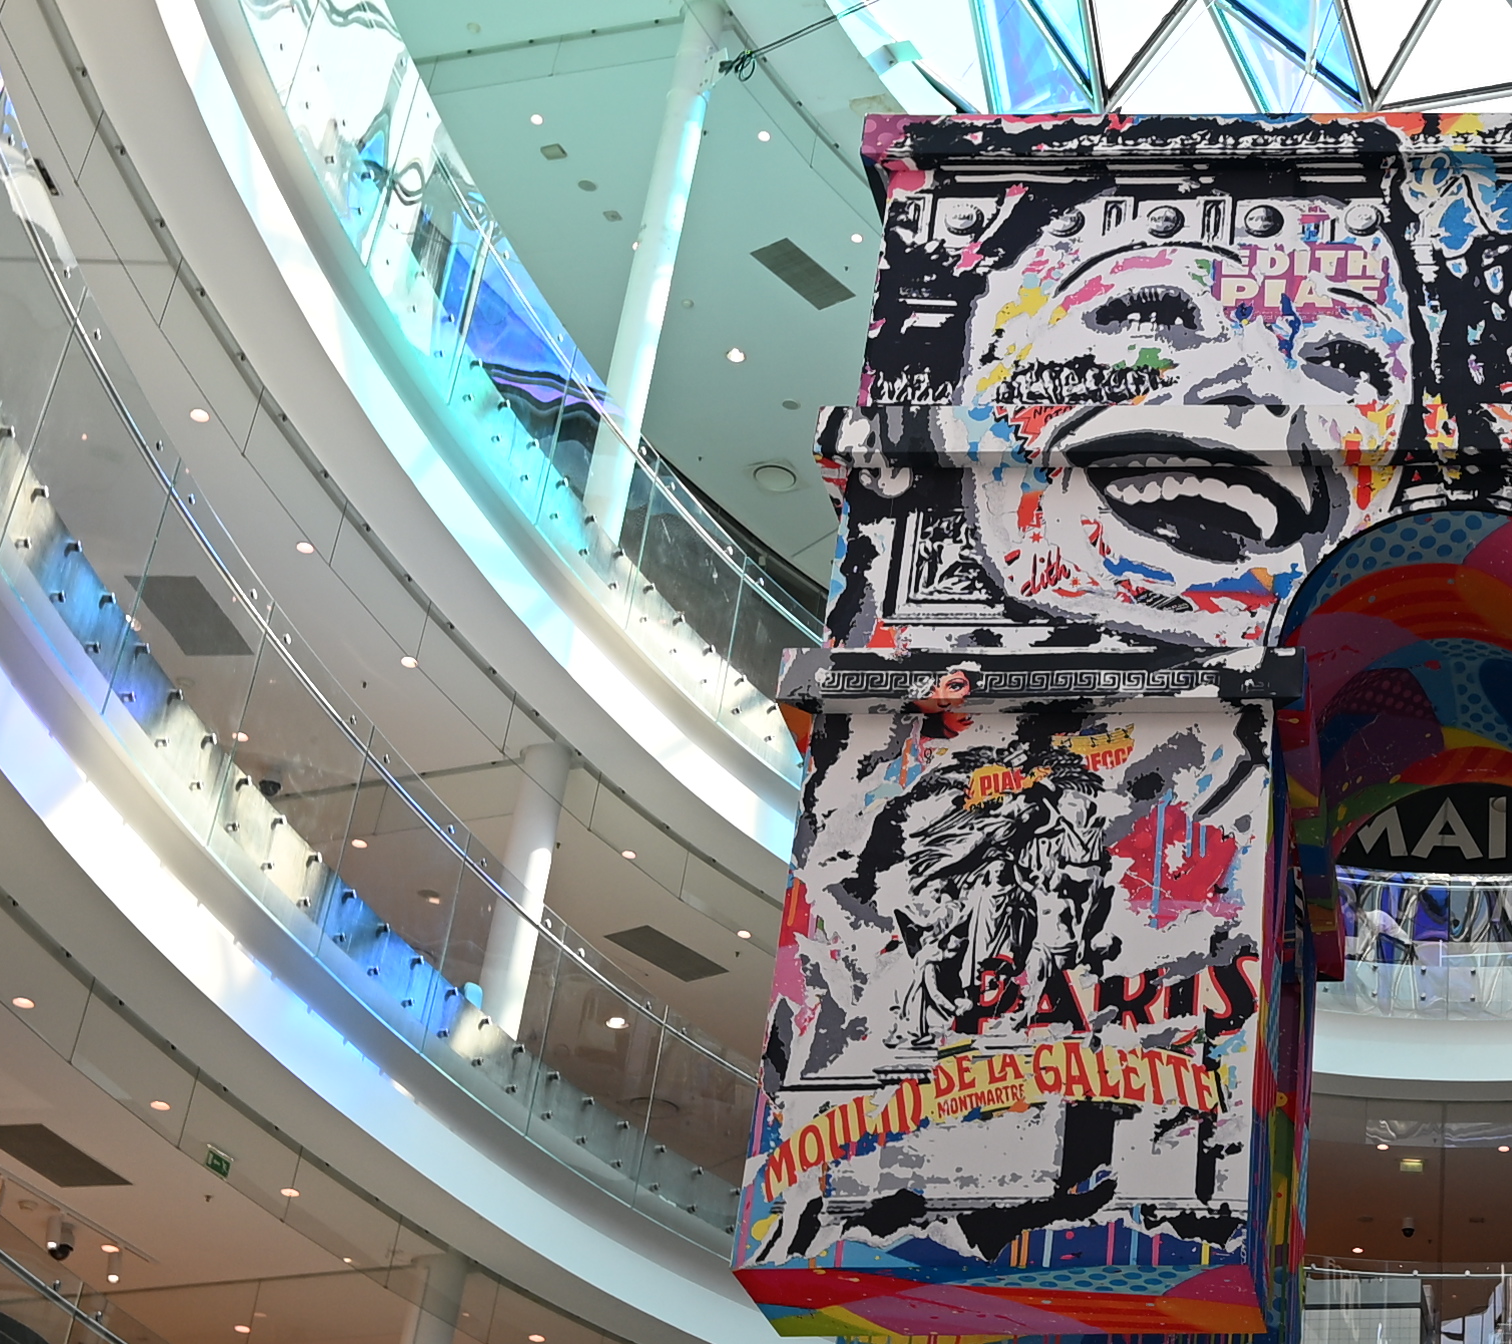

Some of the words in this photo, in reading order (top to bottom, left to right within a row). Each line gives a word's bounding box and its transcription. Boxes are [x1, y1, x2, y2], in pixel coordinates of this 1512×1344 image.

[1221, 249, 1382, 276] EDITH
[952, 954, 1261, 1035] PARIS
[764, 1077, 923, 1203] MOULIN
[933, 1059, 975, 1099] DE
[987, 1052, 1025, 1084] LA
[1031, 1041, 1219, 1113] GALETTE
[936, 1082, 1025, 1119] MONTMARTRE
